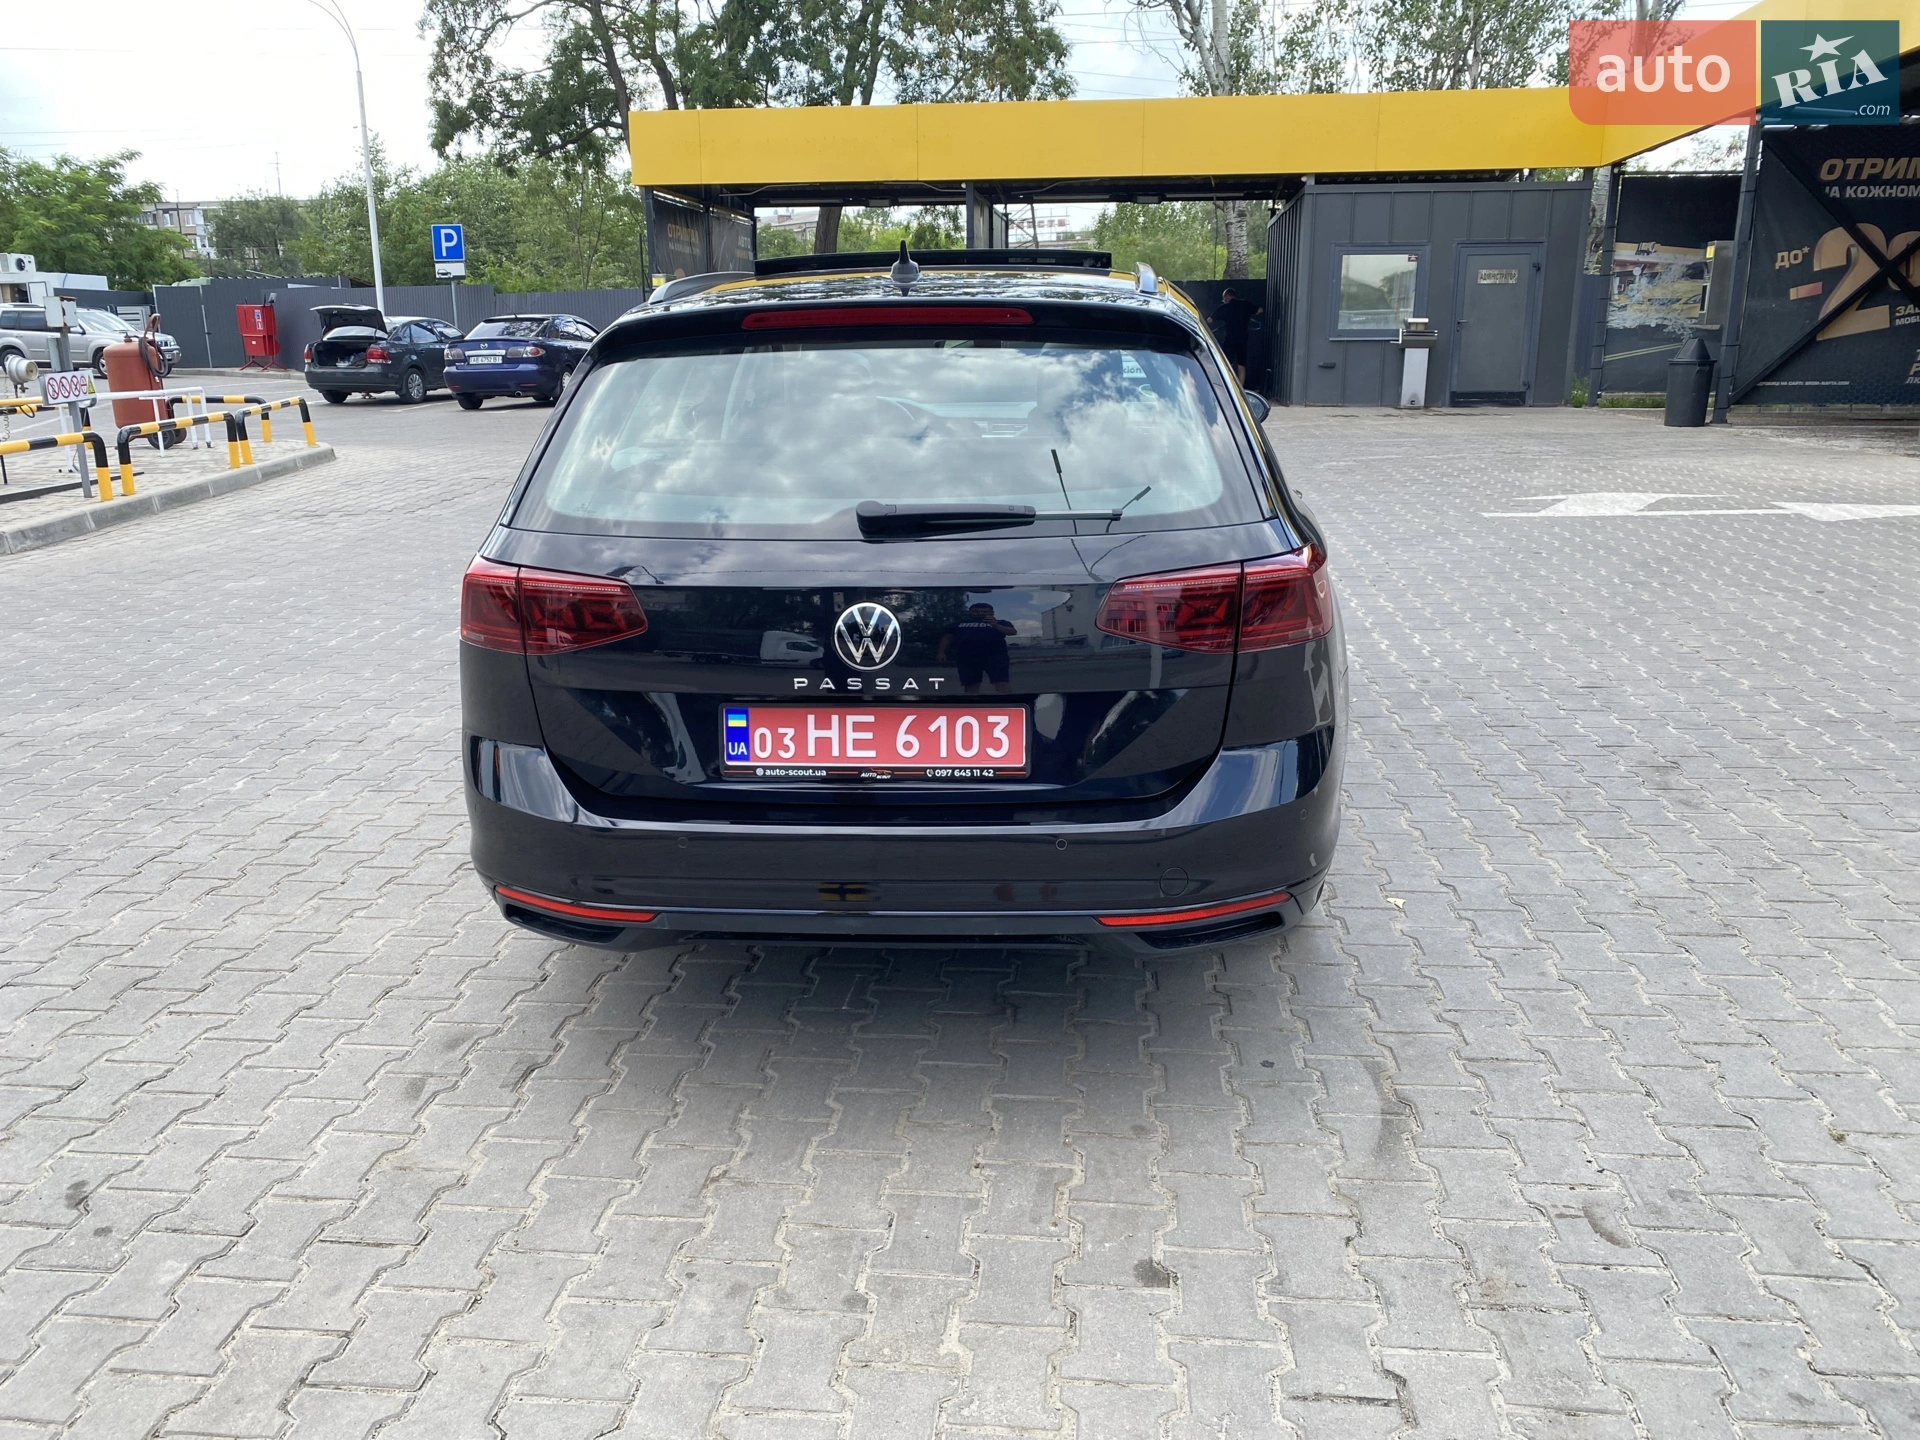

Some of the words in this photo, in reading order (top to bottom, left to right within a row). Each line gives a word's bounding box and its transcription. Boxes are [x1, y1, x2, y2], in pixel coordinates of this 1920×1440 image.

[440, 229, 457, 257] P
[1895, 315, 1920, 326] МОБІ
[793, 677, 945, 690] PASSAT
[729, 742, 747, 756] UA
[754, 728, 796, 759] 03
[807, 714, 876, 758] HE
[895, 714, 1010, 759] 6103
[765, 768, 826, 778] auto-scout.ua
[935, 769, 952, 777] 097
[954, 769, 971, 777] 645
[972, 769, 980, 777] 11
[982, 769, 994, 777] 42
